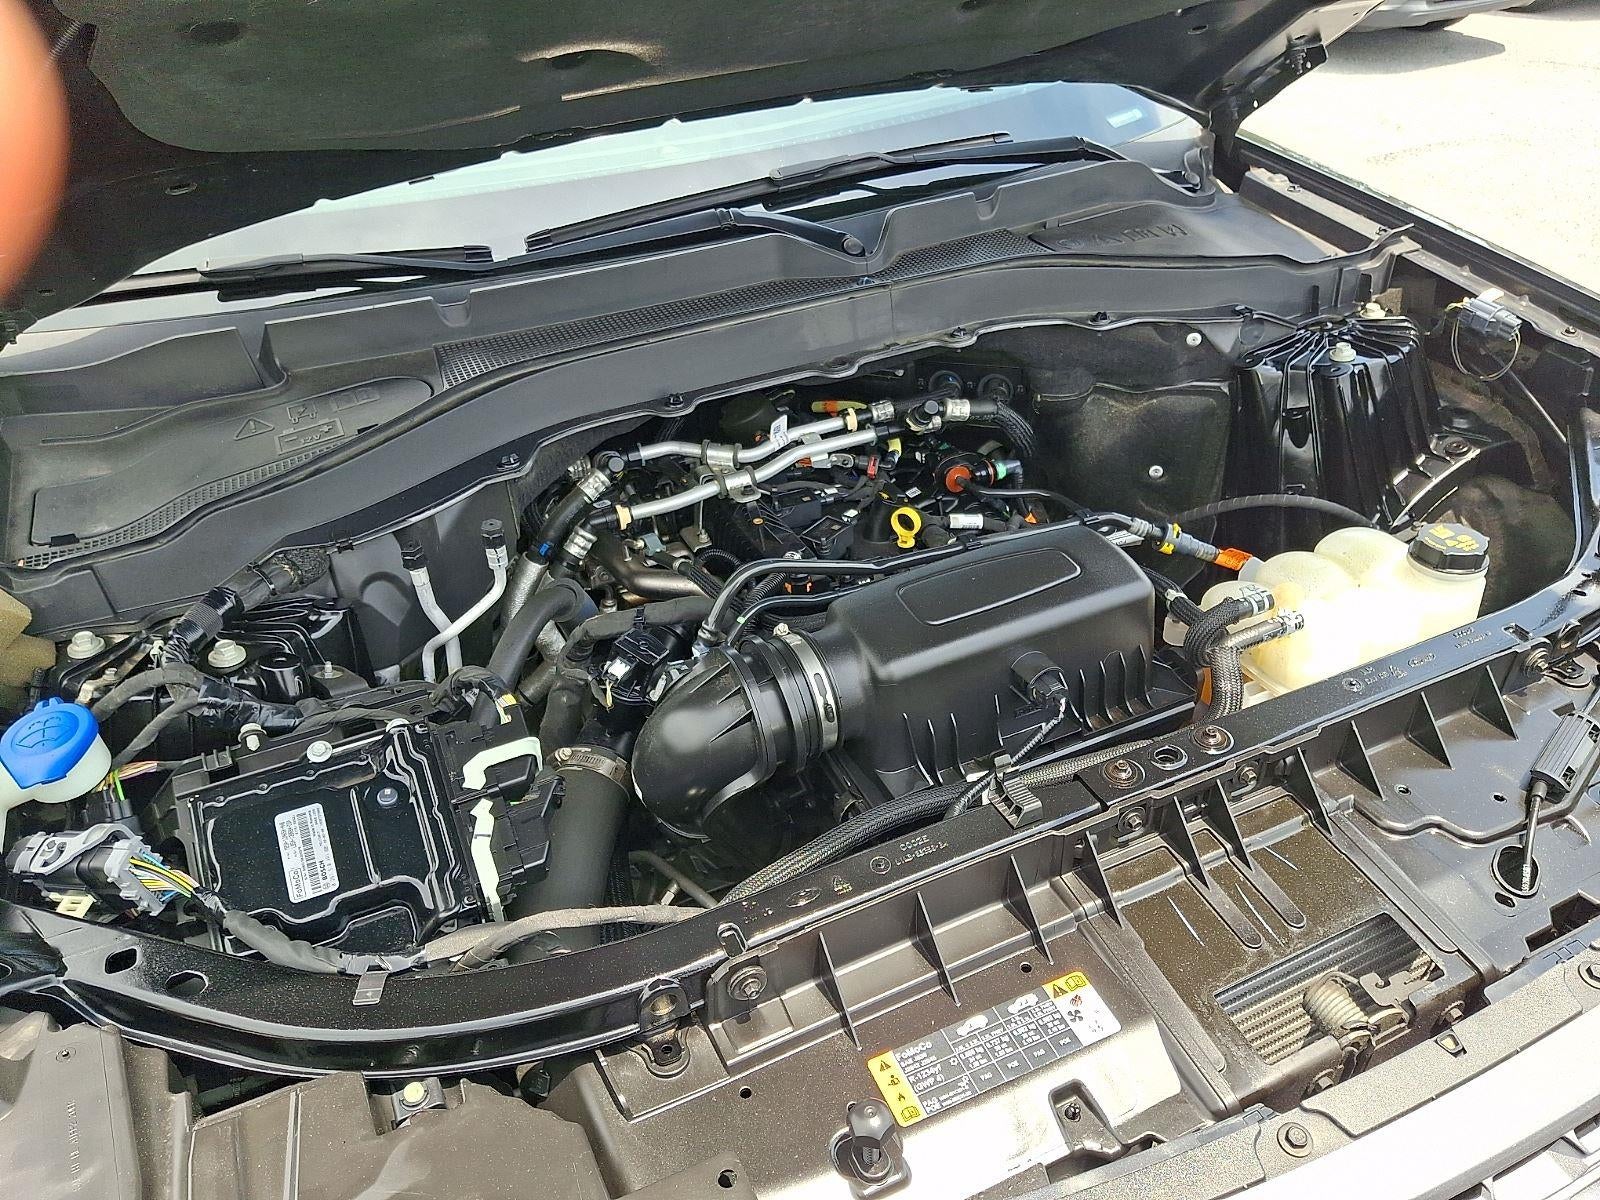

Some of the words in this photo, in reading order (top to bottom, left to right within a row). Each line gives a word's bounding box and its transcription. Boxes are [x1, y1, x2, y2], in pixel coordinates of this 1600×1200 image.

[319, 860, 328, 881] BOSCH
[292, 870, 304, 898] FoMoCo
[895, 1041, 933, 1060] FoMoCo
